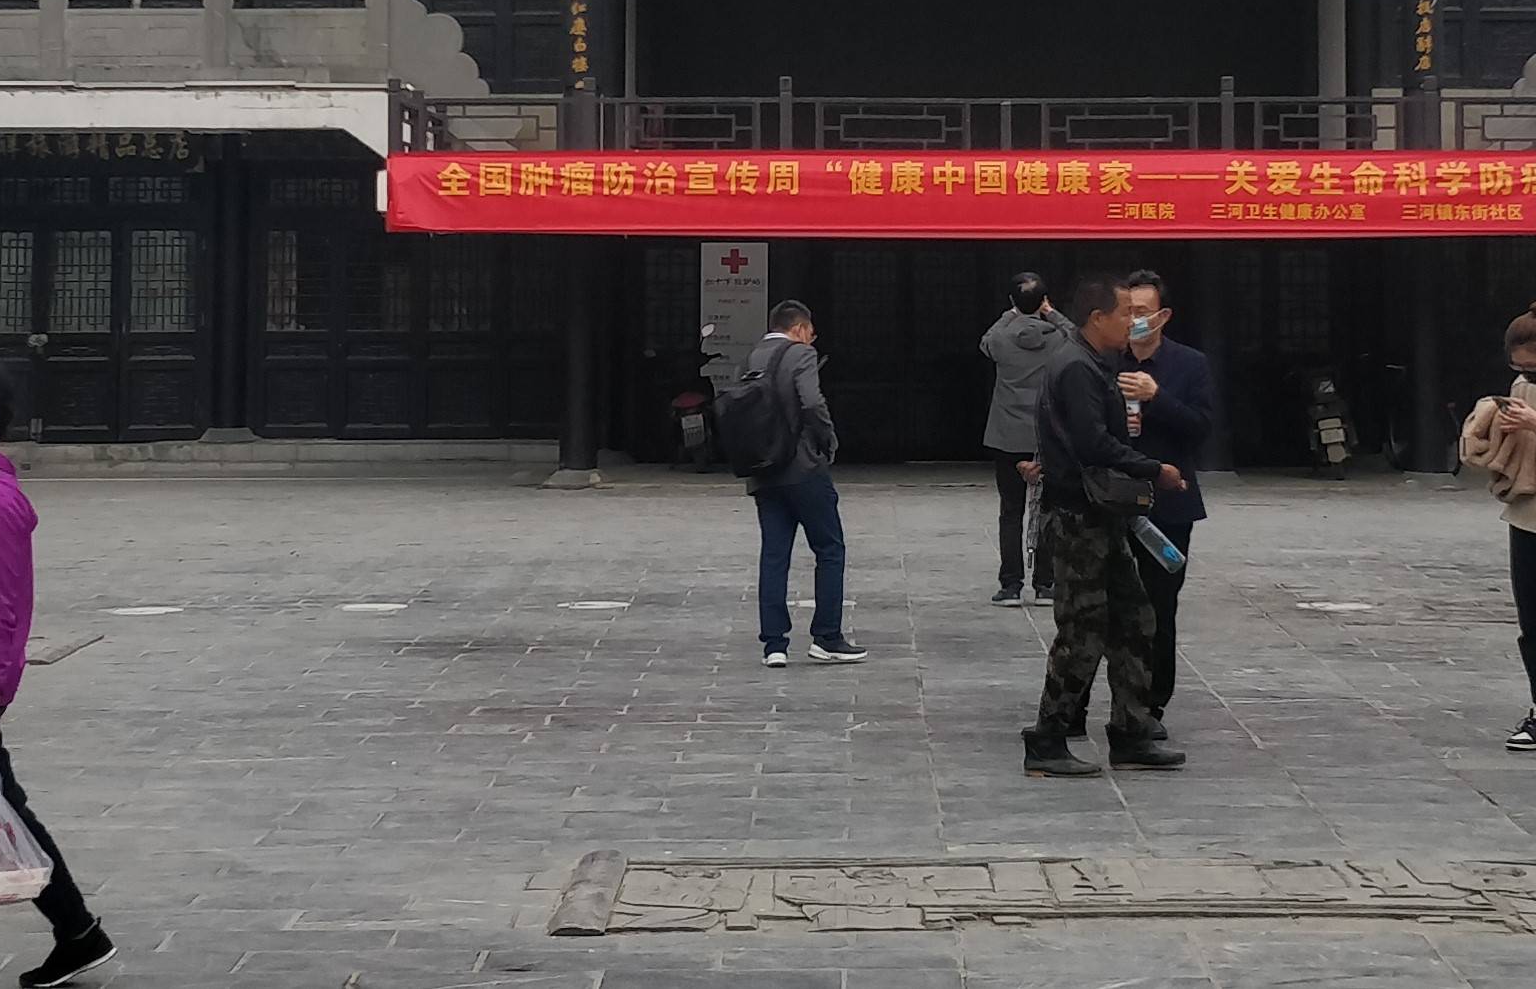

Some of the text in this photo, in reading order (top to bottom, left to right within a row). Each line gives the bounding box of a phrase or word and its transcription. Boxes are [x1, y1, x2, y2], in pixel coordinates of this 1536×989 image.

[1107, 203, 1176, 220] 三河医院
[1210, 203, 1366, 220] 三河卫生健康办公室
[1401, 204, 1524, 221] 三河镇东街社区
